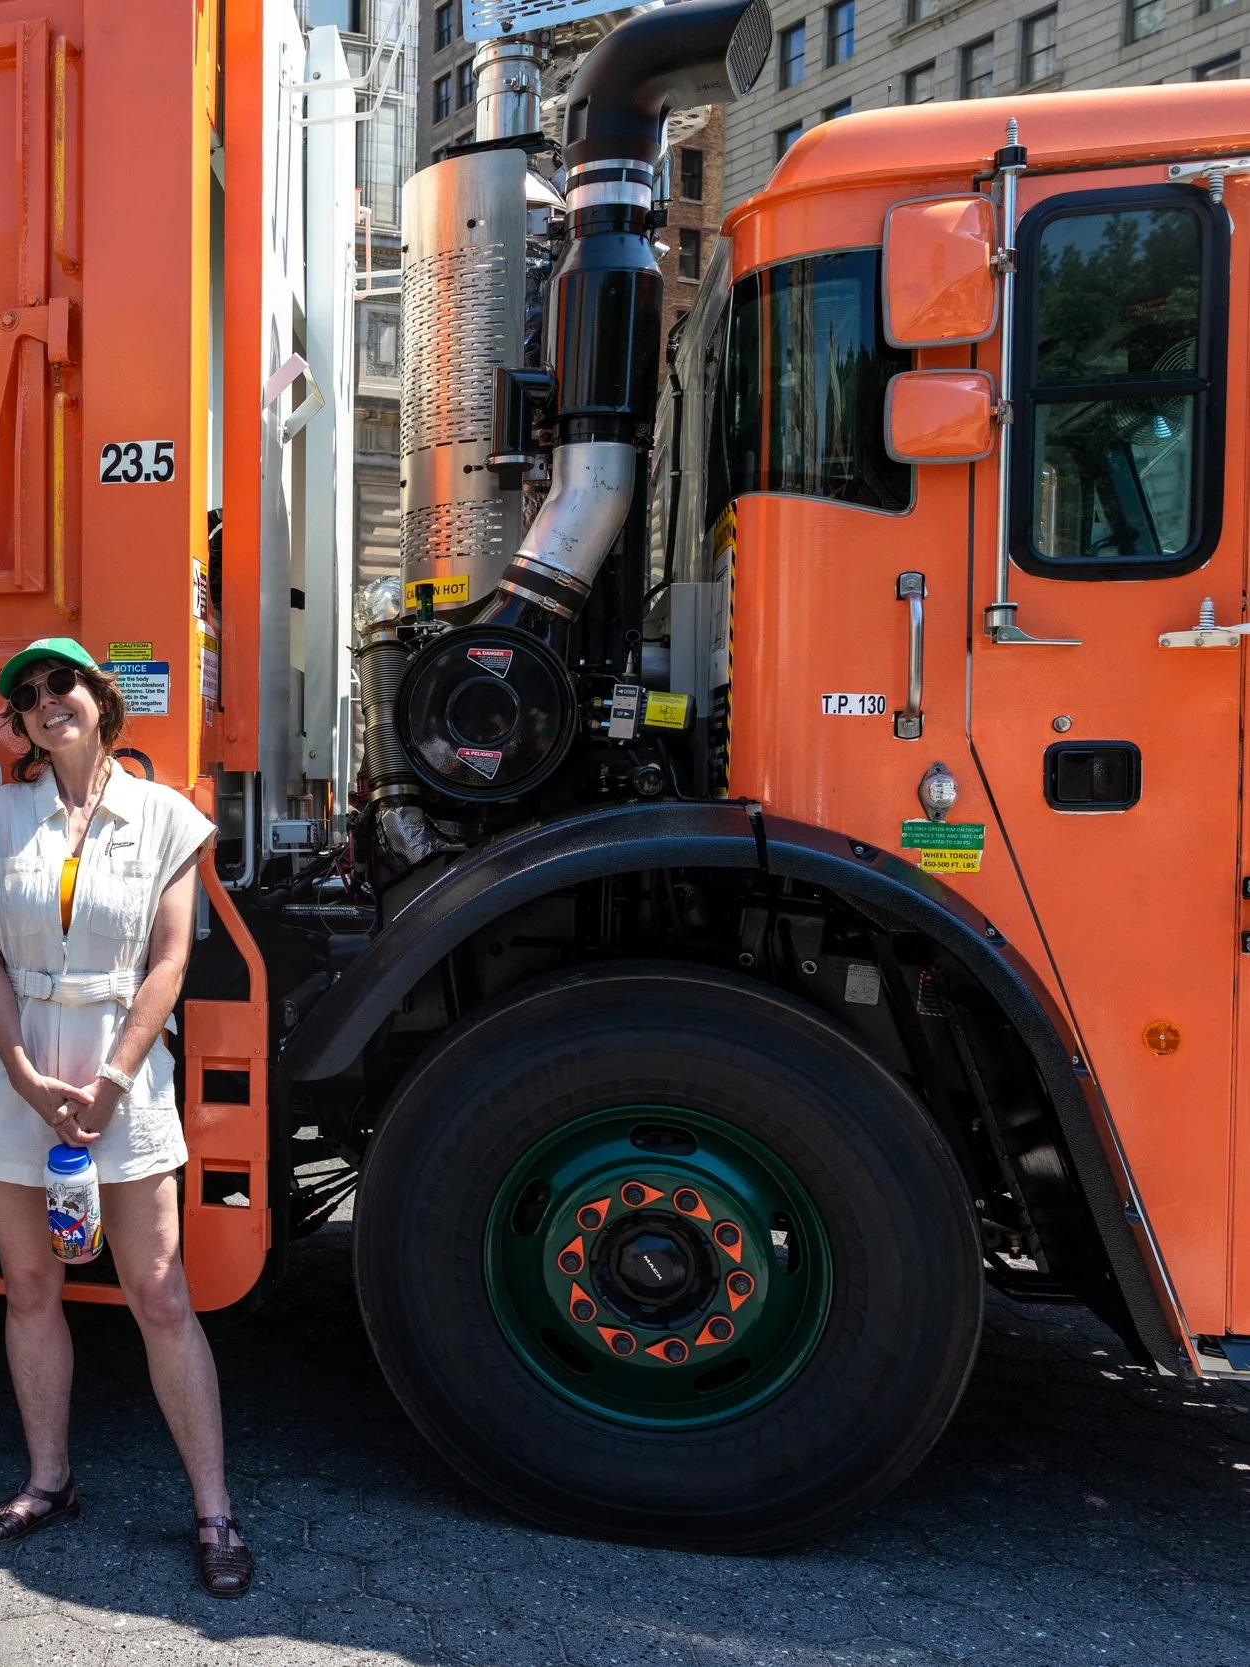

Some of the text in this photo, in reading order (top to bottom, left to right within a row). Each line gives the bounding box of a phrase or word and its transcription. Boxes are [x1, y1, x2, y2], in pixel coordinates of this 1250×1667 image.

[101, 442, 175, 483] 23.5
[443, 584, 466, 595] HOT
[113, 664, 147, 673] NOTICE
[822, 695, 886, 715] T.P. 130
[643, 1255, 663, 1281] MACK
